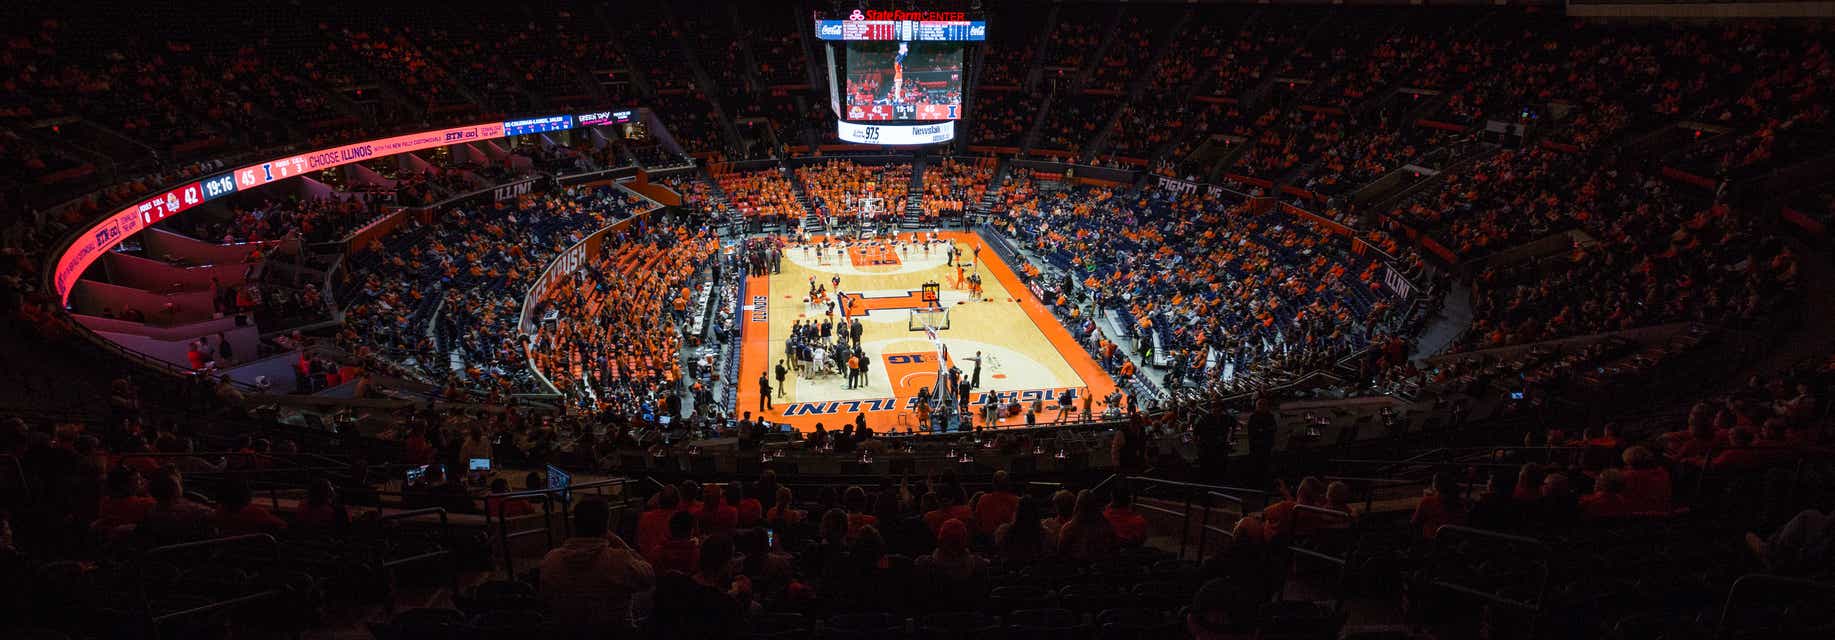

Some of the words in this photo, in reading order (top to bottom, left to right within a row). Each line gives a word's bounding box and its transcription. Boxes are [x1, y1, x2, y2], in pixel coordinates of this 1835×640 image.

[871, 105, 882, 113] 42
[865, 126, 880, 140] 97.5
[310, 151, 340, 169] CHOOSE
[341, 144, 373, 162] ILLINOIS
[206, 176, 233, 197] 19:16
[241, 169, 256, 186] 45
[184, 186, 199, 205] 42
[157, 205, 164, 218] 2
[1384, 267, 1410, 301] ILLINI
[752, 296, 768, 323] ILLINOIS
[782, 398, 896, 417] ILLINI
